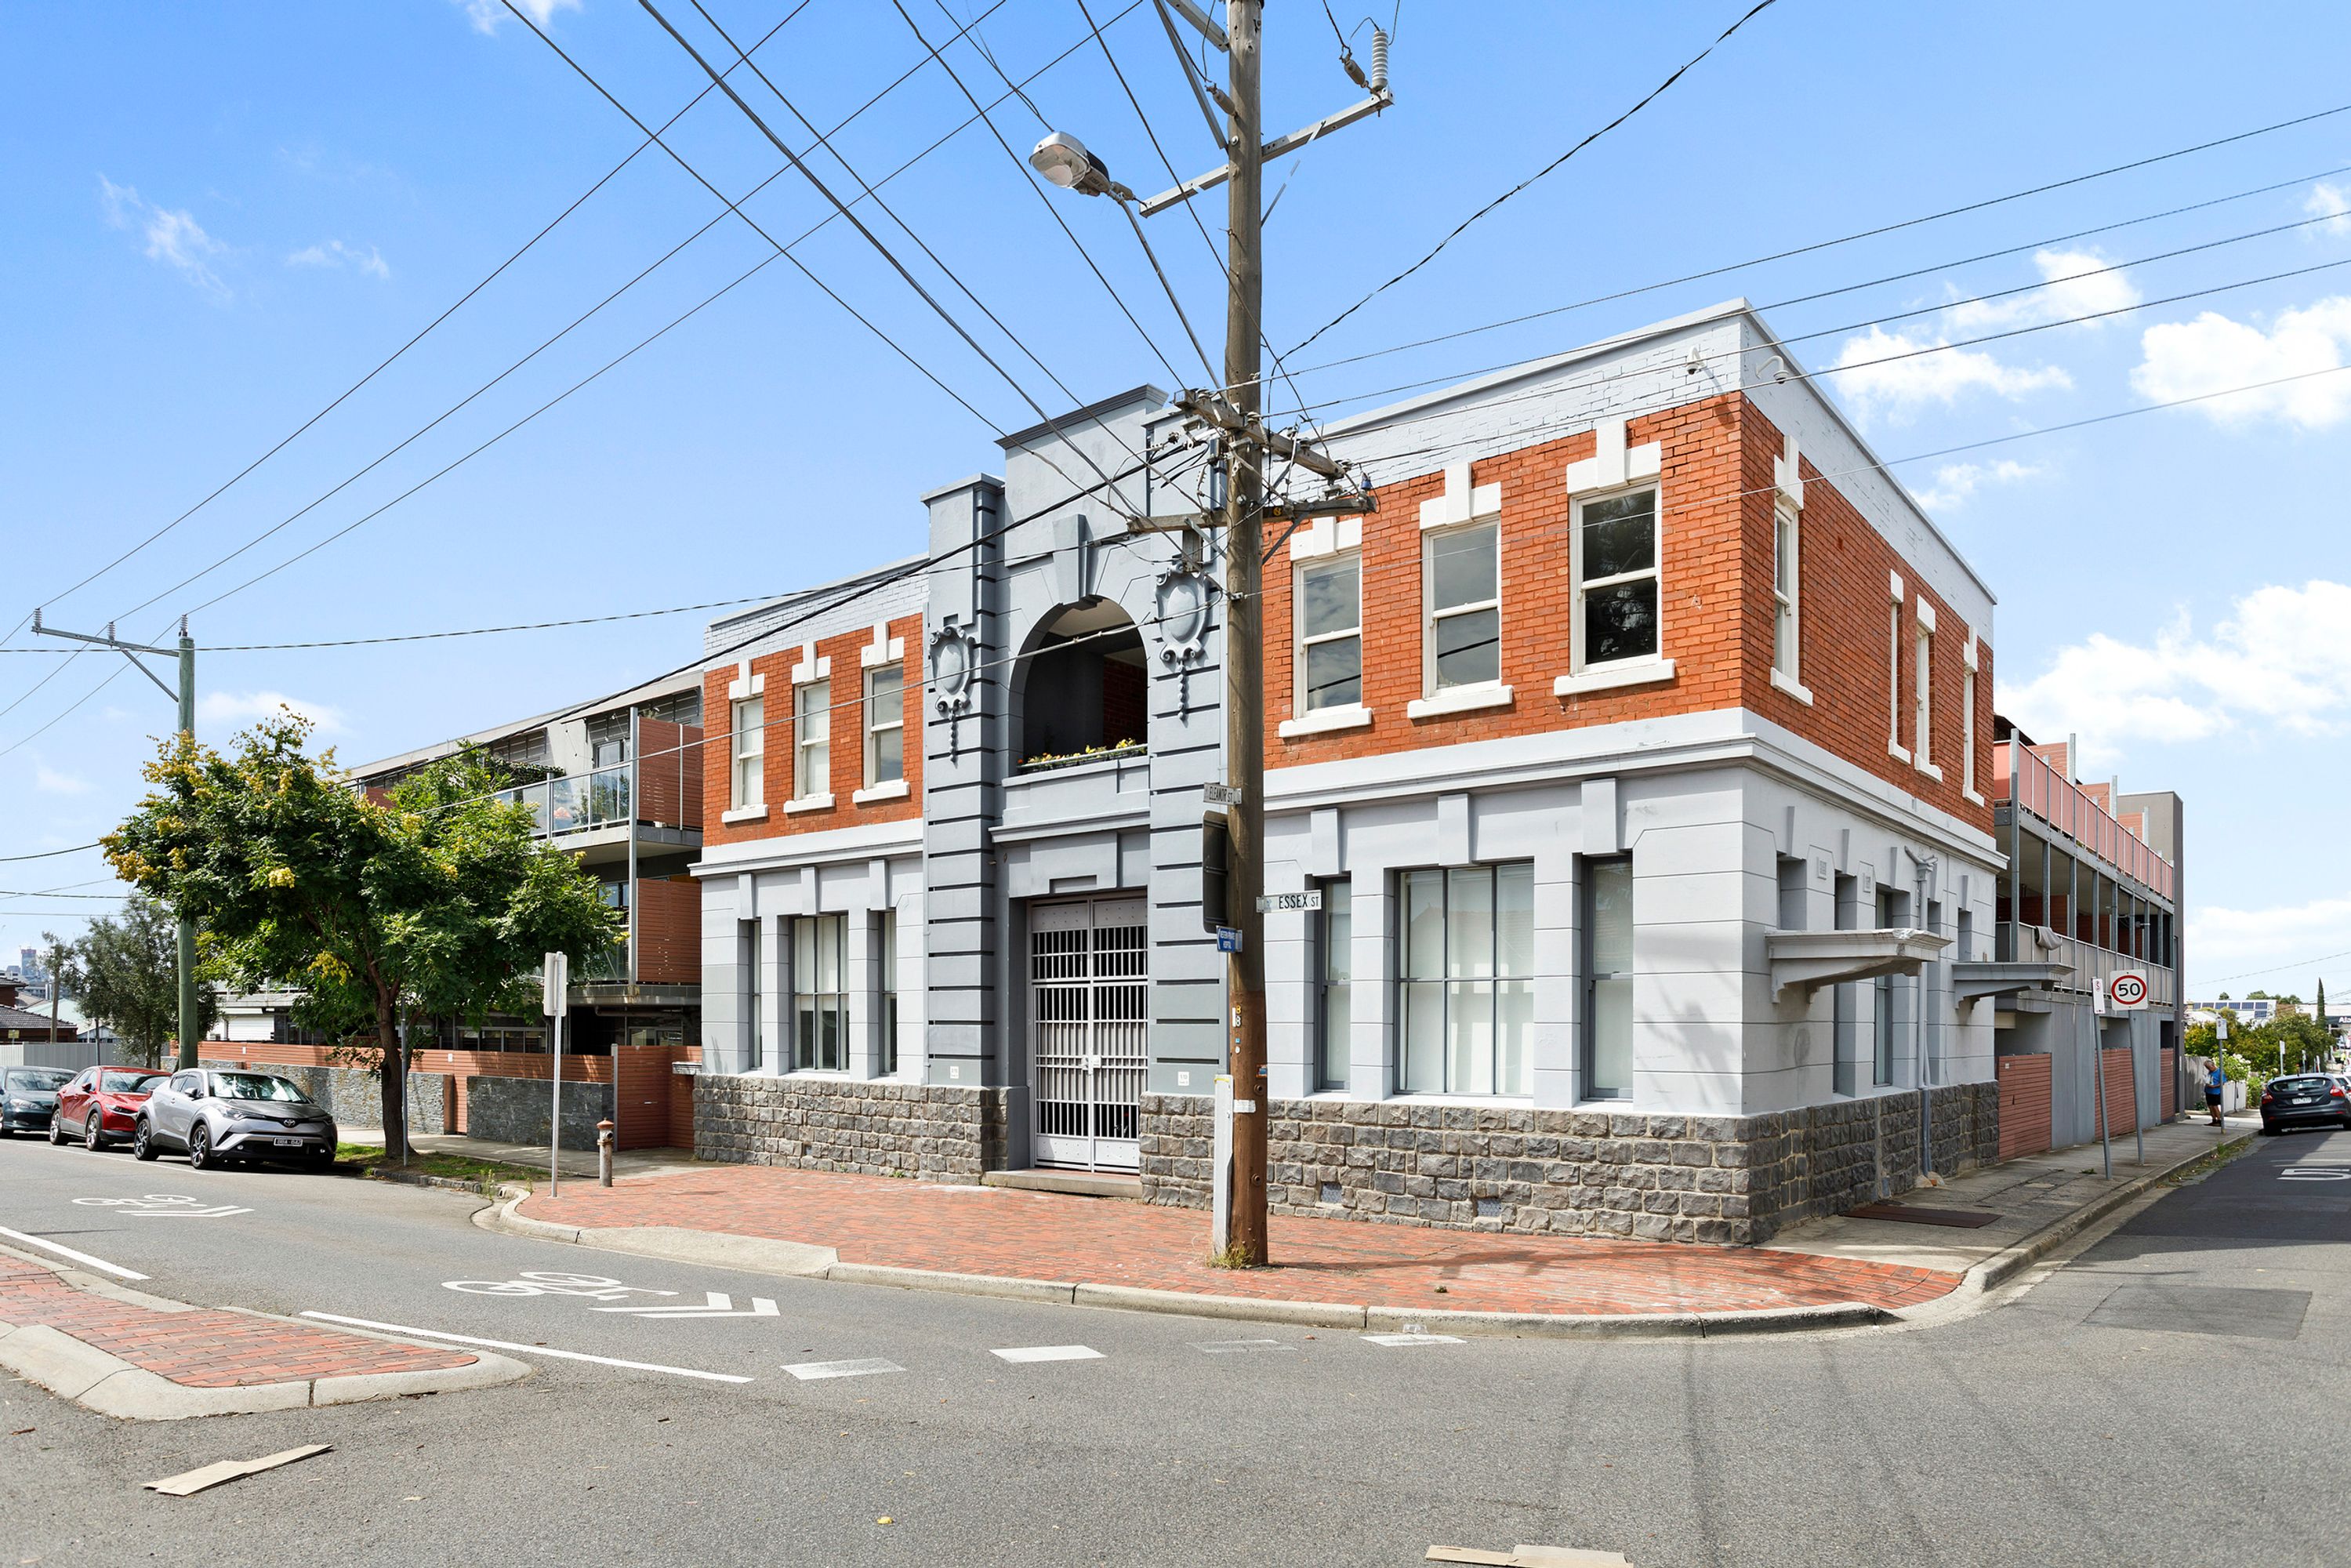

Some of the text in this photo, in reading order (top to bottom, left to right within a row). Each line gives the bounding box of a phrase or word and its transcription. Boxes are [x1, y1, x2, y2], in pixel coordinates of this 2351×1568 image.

[1209, 786, 1233, 803] ELEANOR ST
[1279, 894, 1319, 909] ESSEX ST
[2118, 982, 2141, 997] 50
